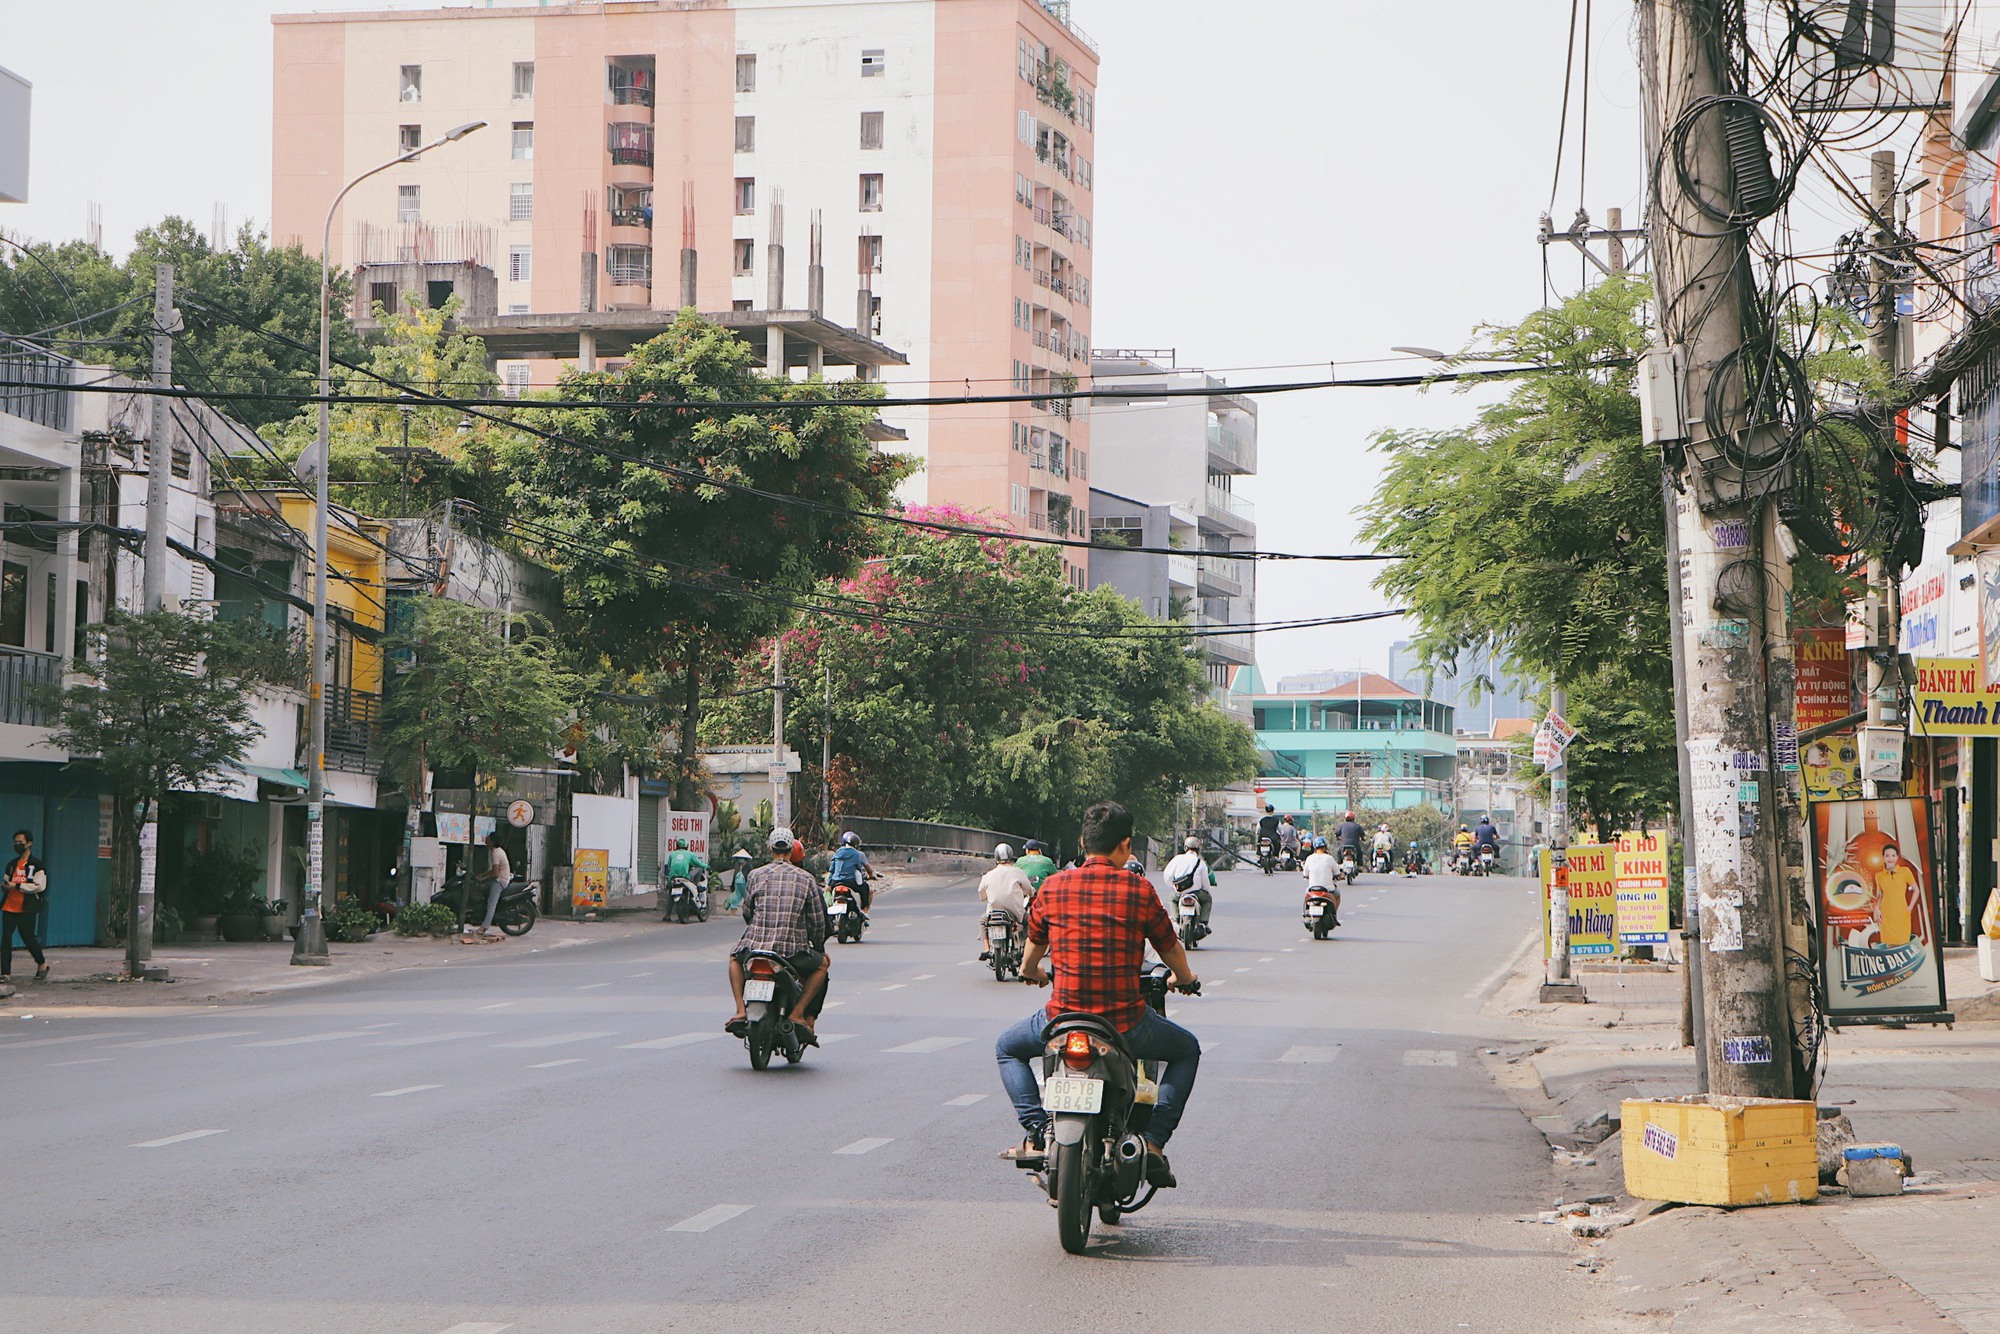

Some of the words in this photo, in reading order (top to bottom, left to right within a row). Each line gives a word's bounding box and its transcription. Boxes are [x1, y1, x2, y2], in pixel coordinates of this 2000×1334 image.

[1803, 636, 1845, 661] KÍNH
[1822, 681, 1847, 692] ĐỘNG
[1919, 662, 1956, 693] BÁNH
[1960, 663, 1976, 693] MÌ
[1802, 694, 1829, 704] CHÍNH
[1830, 694, 1848, 704] XÁC
[1922, 699, 1988, 725] Thanh
[672, 815, 689, 831] SIÊU
[690, 818, 703, 834] THỊ
[690, 836, 705, 852] BÀN
[1590, 851, 1606, 872] MÌ
[1623, 857, 1662, 875] KÍNH
[1586, 881, 1613, 898] BAO
[1585, 902, 1614, 940] Hằng
[1055, 1080, 1095, 1096] 60-Y8
[1053, 1095, 1093, 1110] 3845
